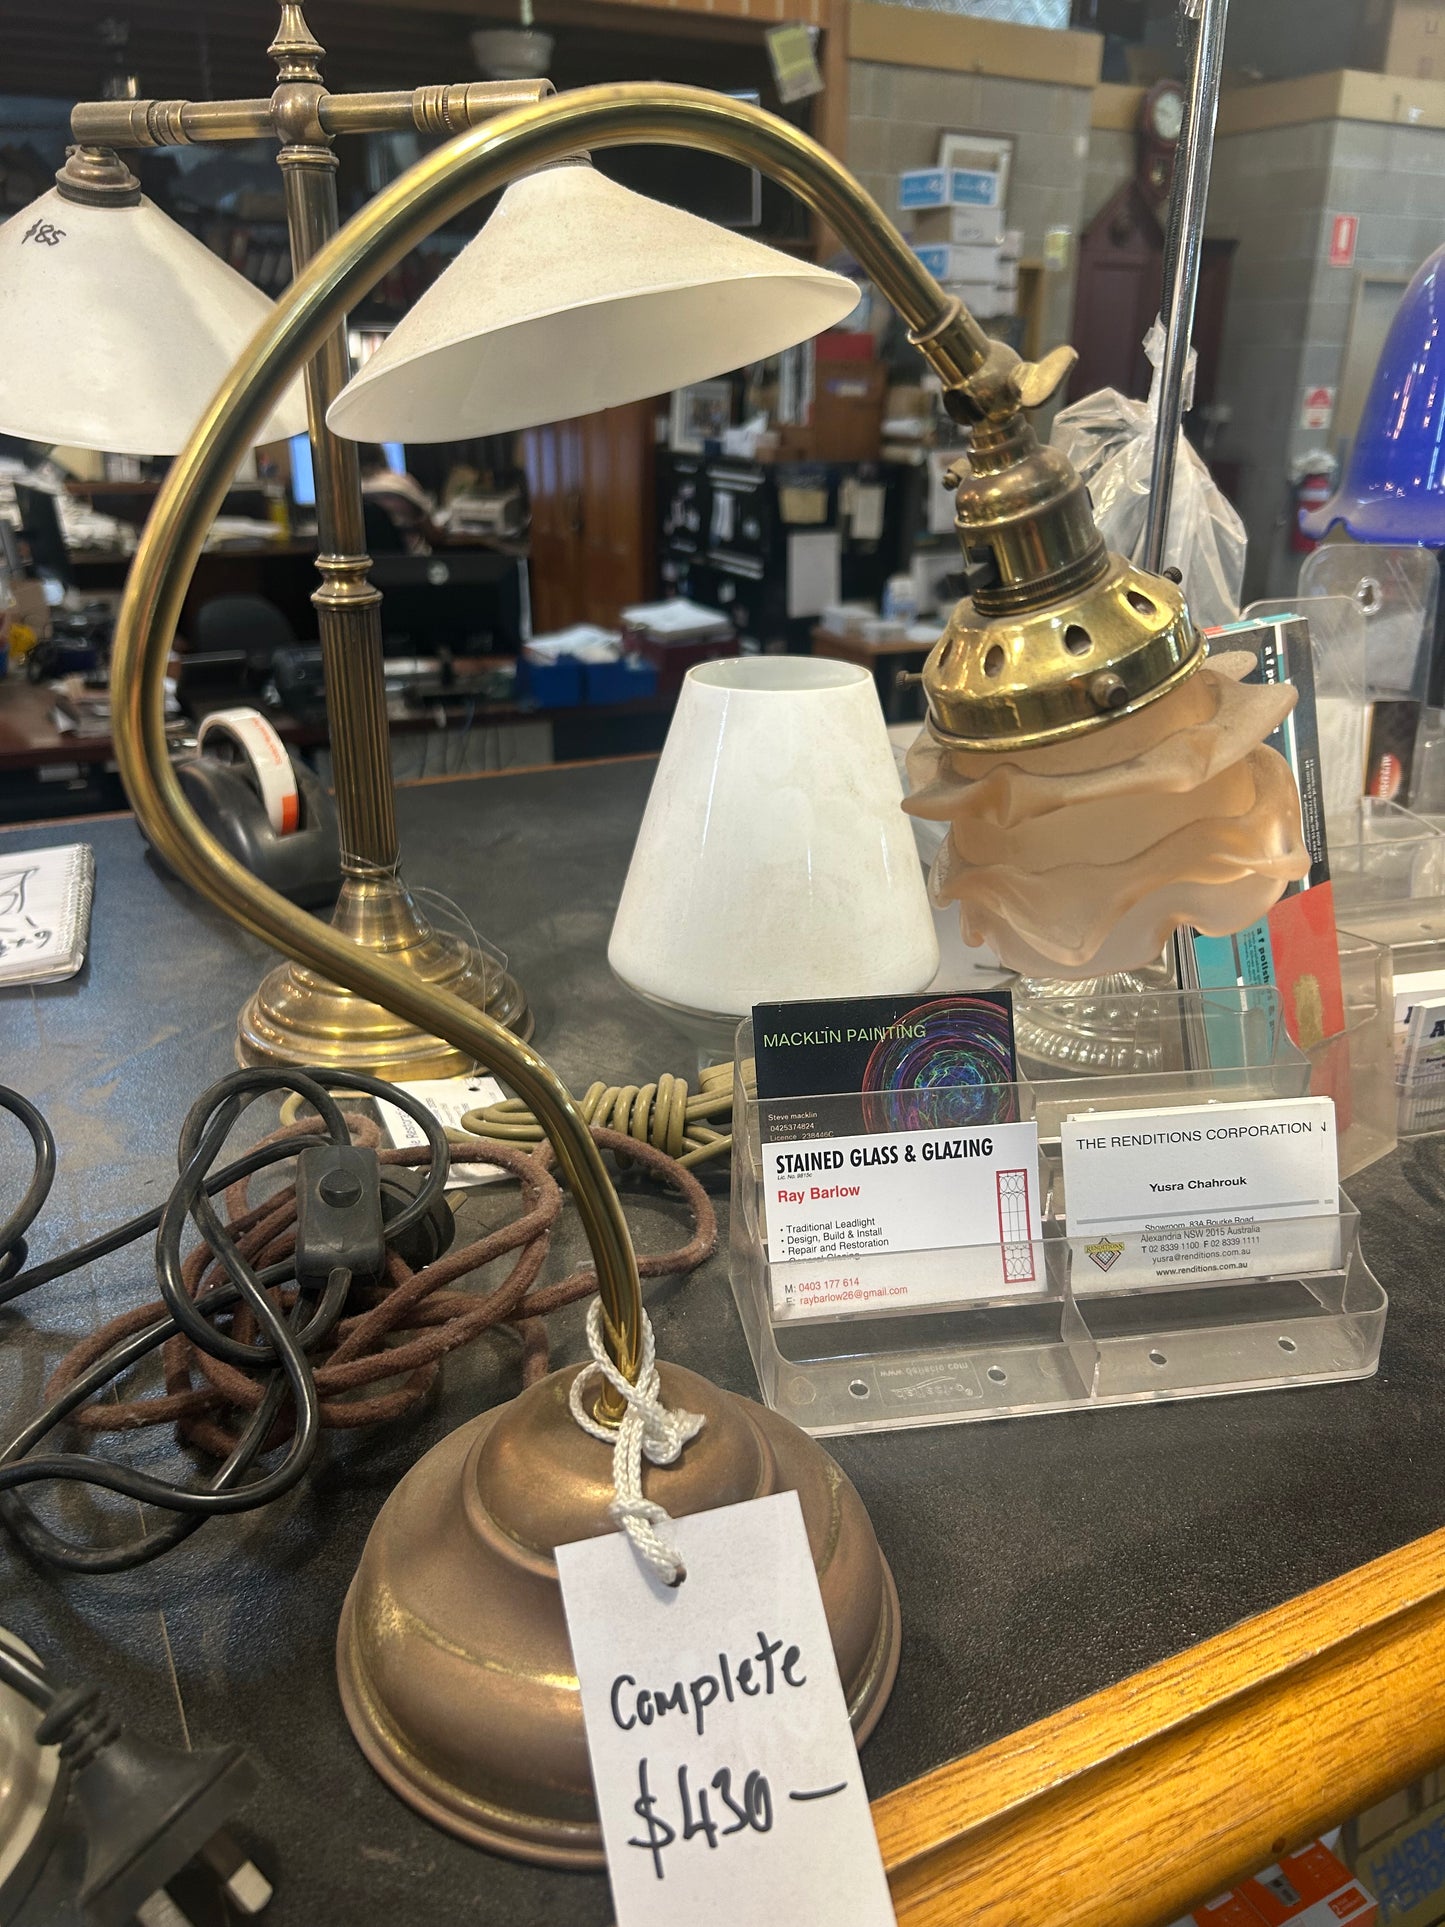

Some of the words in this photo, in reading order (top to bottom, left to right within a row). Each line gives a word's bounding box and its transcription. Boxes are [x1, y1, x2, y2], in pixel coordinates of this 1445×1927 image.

[21, 218, 67, 246] $85
[763, 1030, 841, 1048] MACKLIN
[847, 1024, 926, 1042] PAINTING
[768, 1114, 789, 1122] Steve
[790, 1112, 818, 1120] macklin
[770, 1122, 815, 1132] 0425374824
[1076, 1137, 1107, 1150] THE
[1111, 1130, 1202, 1147] RENDITIONS
[1205, 1122, 1312, 1140] CORPORATION
[776, 1151, 844, 1173] STAINED
[850, 1145, 898, 1167] GLASS
[904, 1145, 917, 1162] &
[922, 1138, 993, 1161] GLAZING
[1149, 1180, 1184, 1193] Yusra
[1187, 1176, 1248, 1190] Chahrouk
[778, 1190, 805, 1204] Ray
[810, 1186, 860, 1200] Barlow
[786, 1221, 833, 1234] Traditional
[835, 1218, 876, 1230] Leadlight
[1141, 1231, 1182, 1242] Alexandria
[1184, 1229, 1204, 1239] NSW
[1206, 1227, 1226, 1237] 2015
[1227, 1224, 1261, 1235] Australia
[787, 1234, 820, 1246] Design,
[823, 1230, 845, 1241] Build
[848, 1230, 854, 1238] &
[857, 1227, 883, 1238] Install
[1148, 1245, 1158, 1253] 02
[1160, 1243, 1179, 1252] 8339
[1182, 1241, 1200, 1250] 1100
[1203, 1240, 1209, 1248] F
[1210, 1239, 1220, 1248] 02
[1222, 1237, 1241, 1247] 8339
[1242, 1236, 1260, 1245] 1111
[788, 1244, 817, 1256] Repair
[820, 1241, 836, 1251] and
[839, 1238, 889, 1250] Restoration
[1152, 1249, 1252, 1265] yusra@renditions.com.au
[1156, 1262, 1248, 1277] www.renditions.com.au
[785, 1284, 796, 1295] M:
[799, 1281, 821, 1292] 0403
[824, 1279, 840, 1289] 177
[843, 1277, 859, 1287] 614
[800, 1285, 908, 1305] raybarlow26@gmail.com
[610, 1631, 807, 1736] Complete
[627, 1757, 774, 1879] $430
